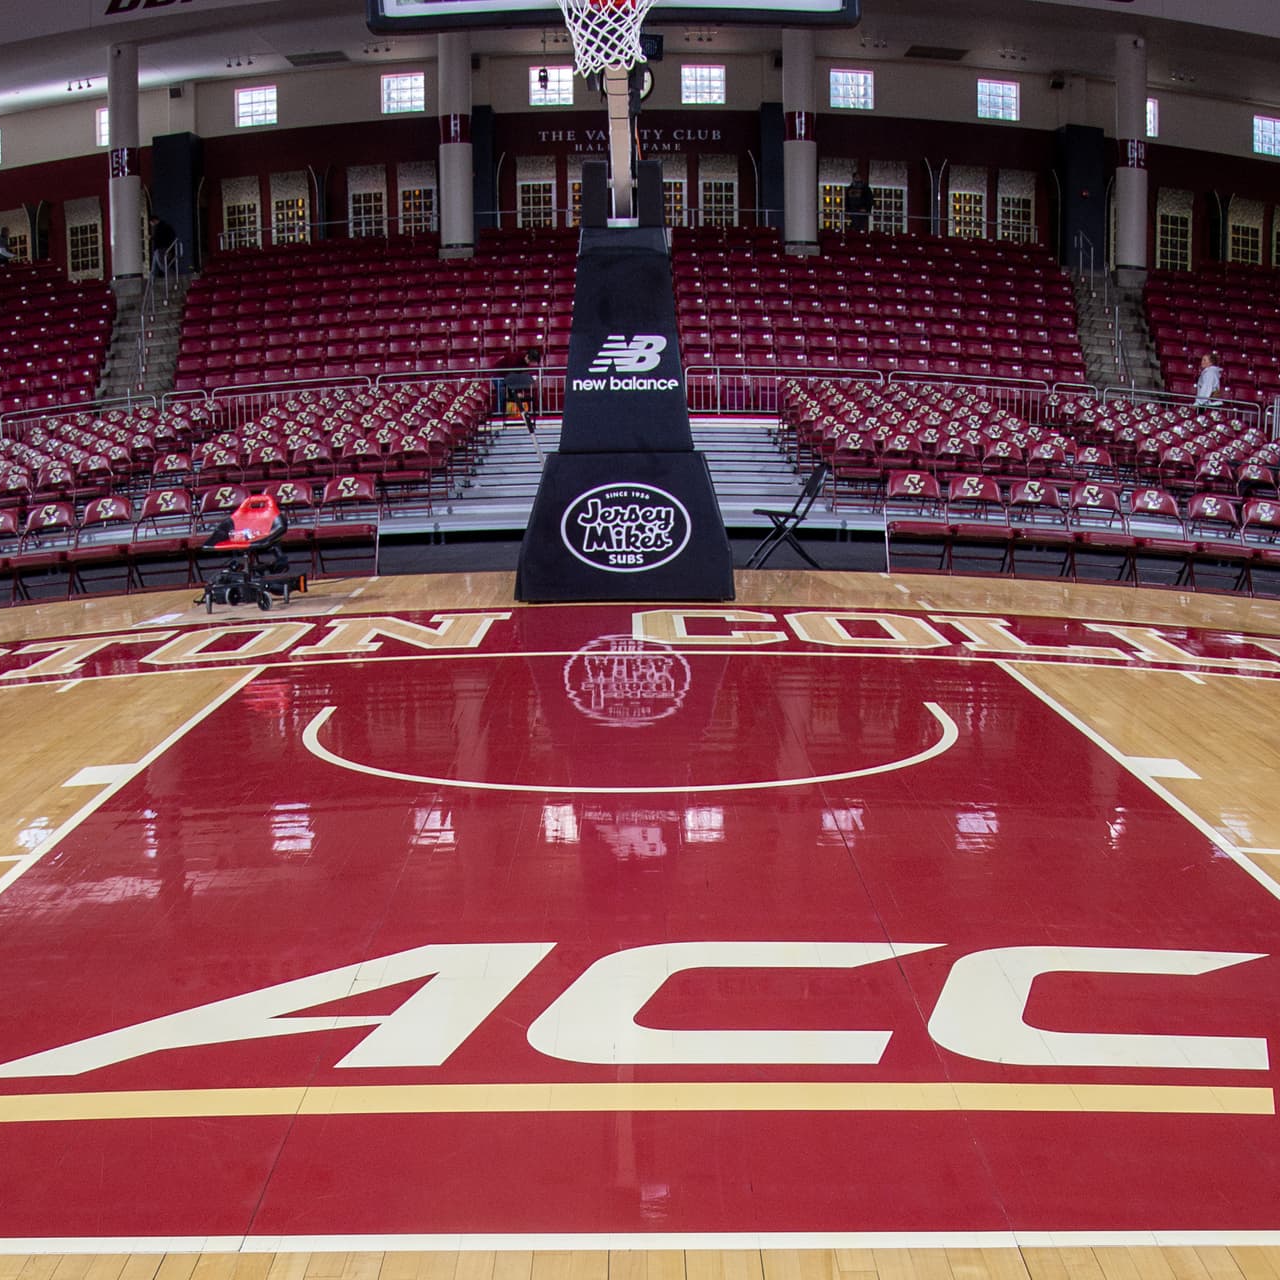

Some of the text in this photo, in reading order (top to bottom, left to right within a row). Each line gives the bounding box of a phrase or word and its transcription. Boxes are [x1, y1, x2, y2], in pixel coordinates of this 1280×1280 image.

[538, 130, 576, 142] THE
[673, 129, 721, 141] CLUB
[573, 376, 679, 391] new balance
[605, 491, 628, 499] SINCE
[578, 499, 674, 531] Jersey
[583, 522, 673, 552] Mike's
[608, 553, 644, 565] SUBS
